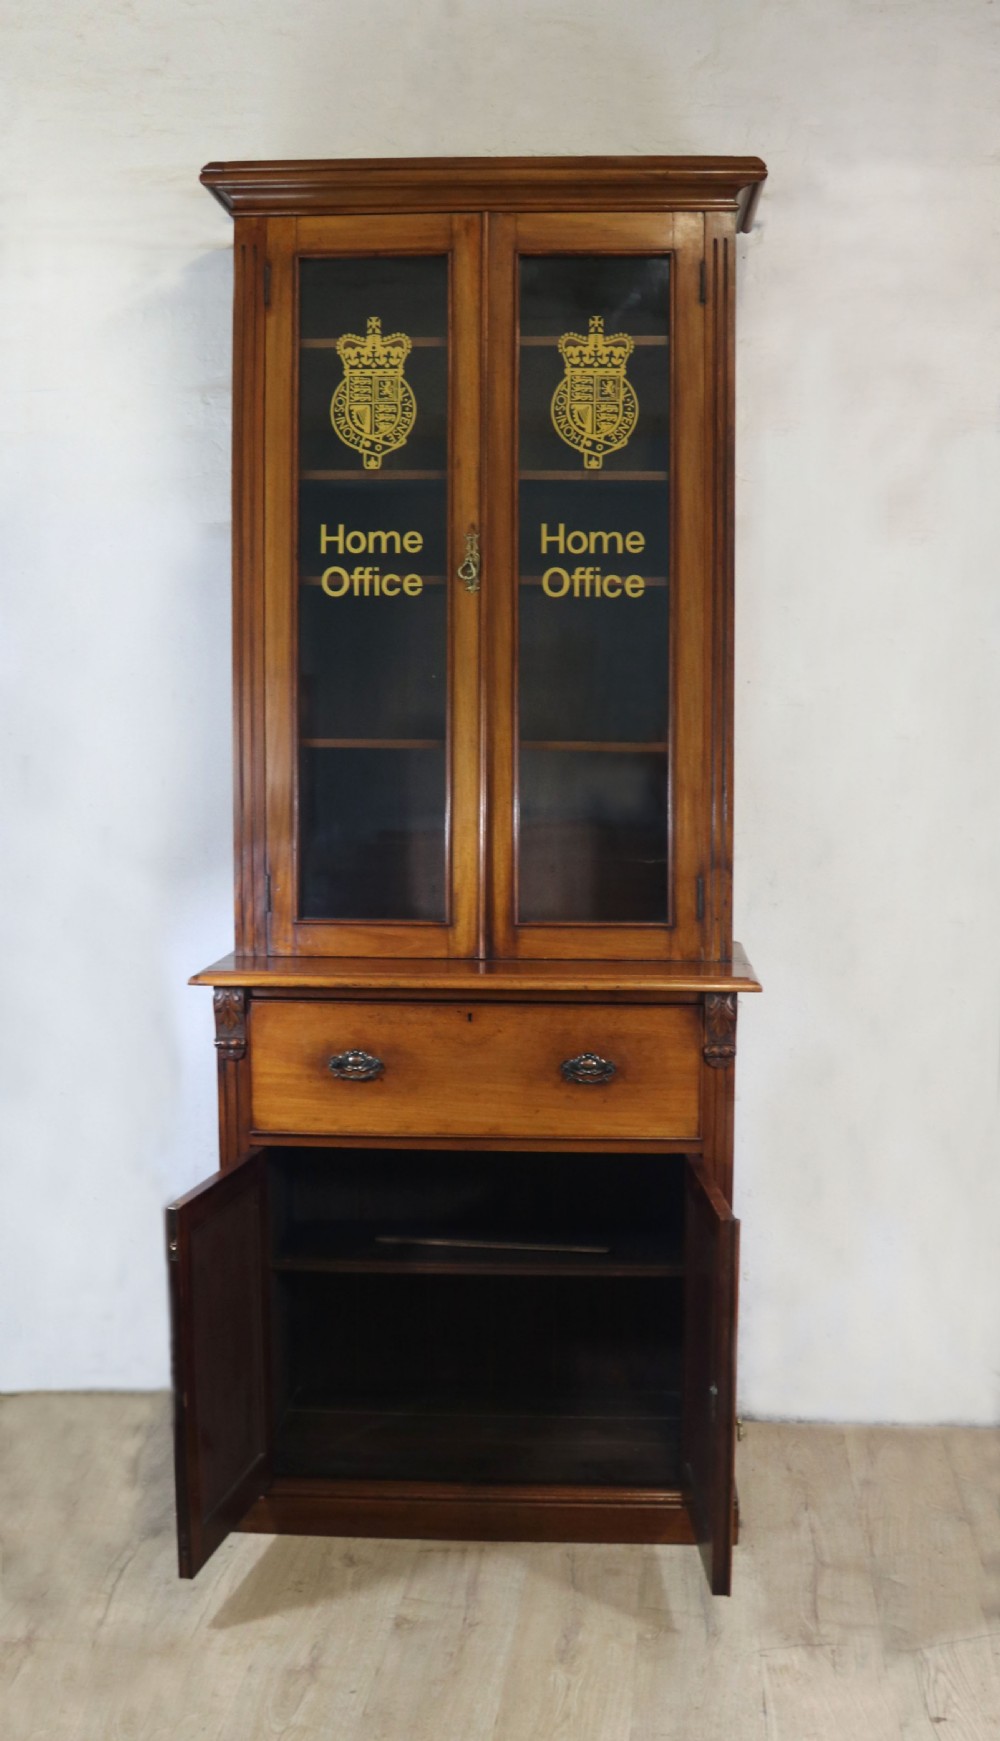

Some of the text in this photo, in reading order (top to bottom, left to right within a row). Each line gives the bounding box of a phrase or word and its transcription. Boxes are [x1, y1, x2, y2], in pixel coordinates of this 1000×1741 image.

[335, 416, 361, 445] HONI
[386, 411, 413, 444] PENSE
[555, 415, 582, 444] HONI
[608, 411, 635, 443] PENSE
[320, 524, 424, 554] Home
[541, 523, 645, 554] Home
[321, 566, 423, 597] Office
[542, 566, 645, 598] Office
